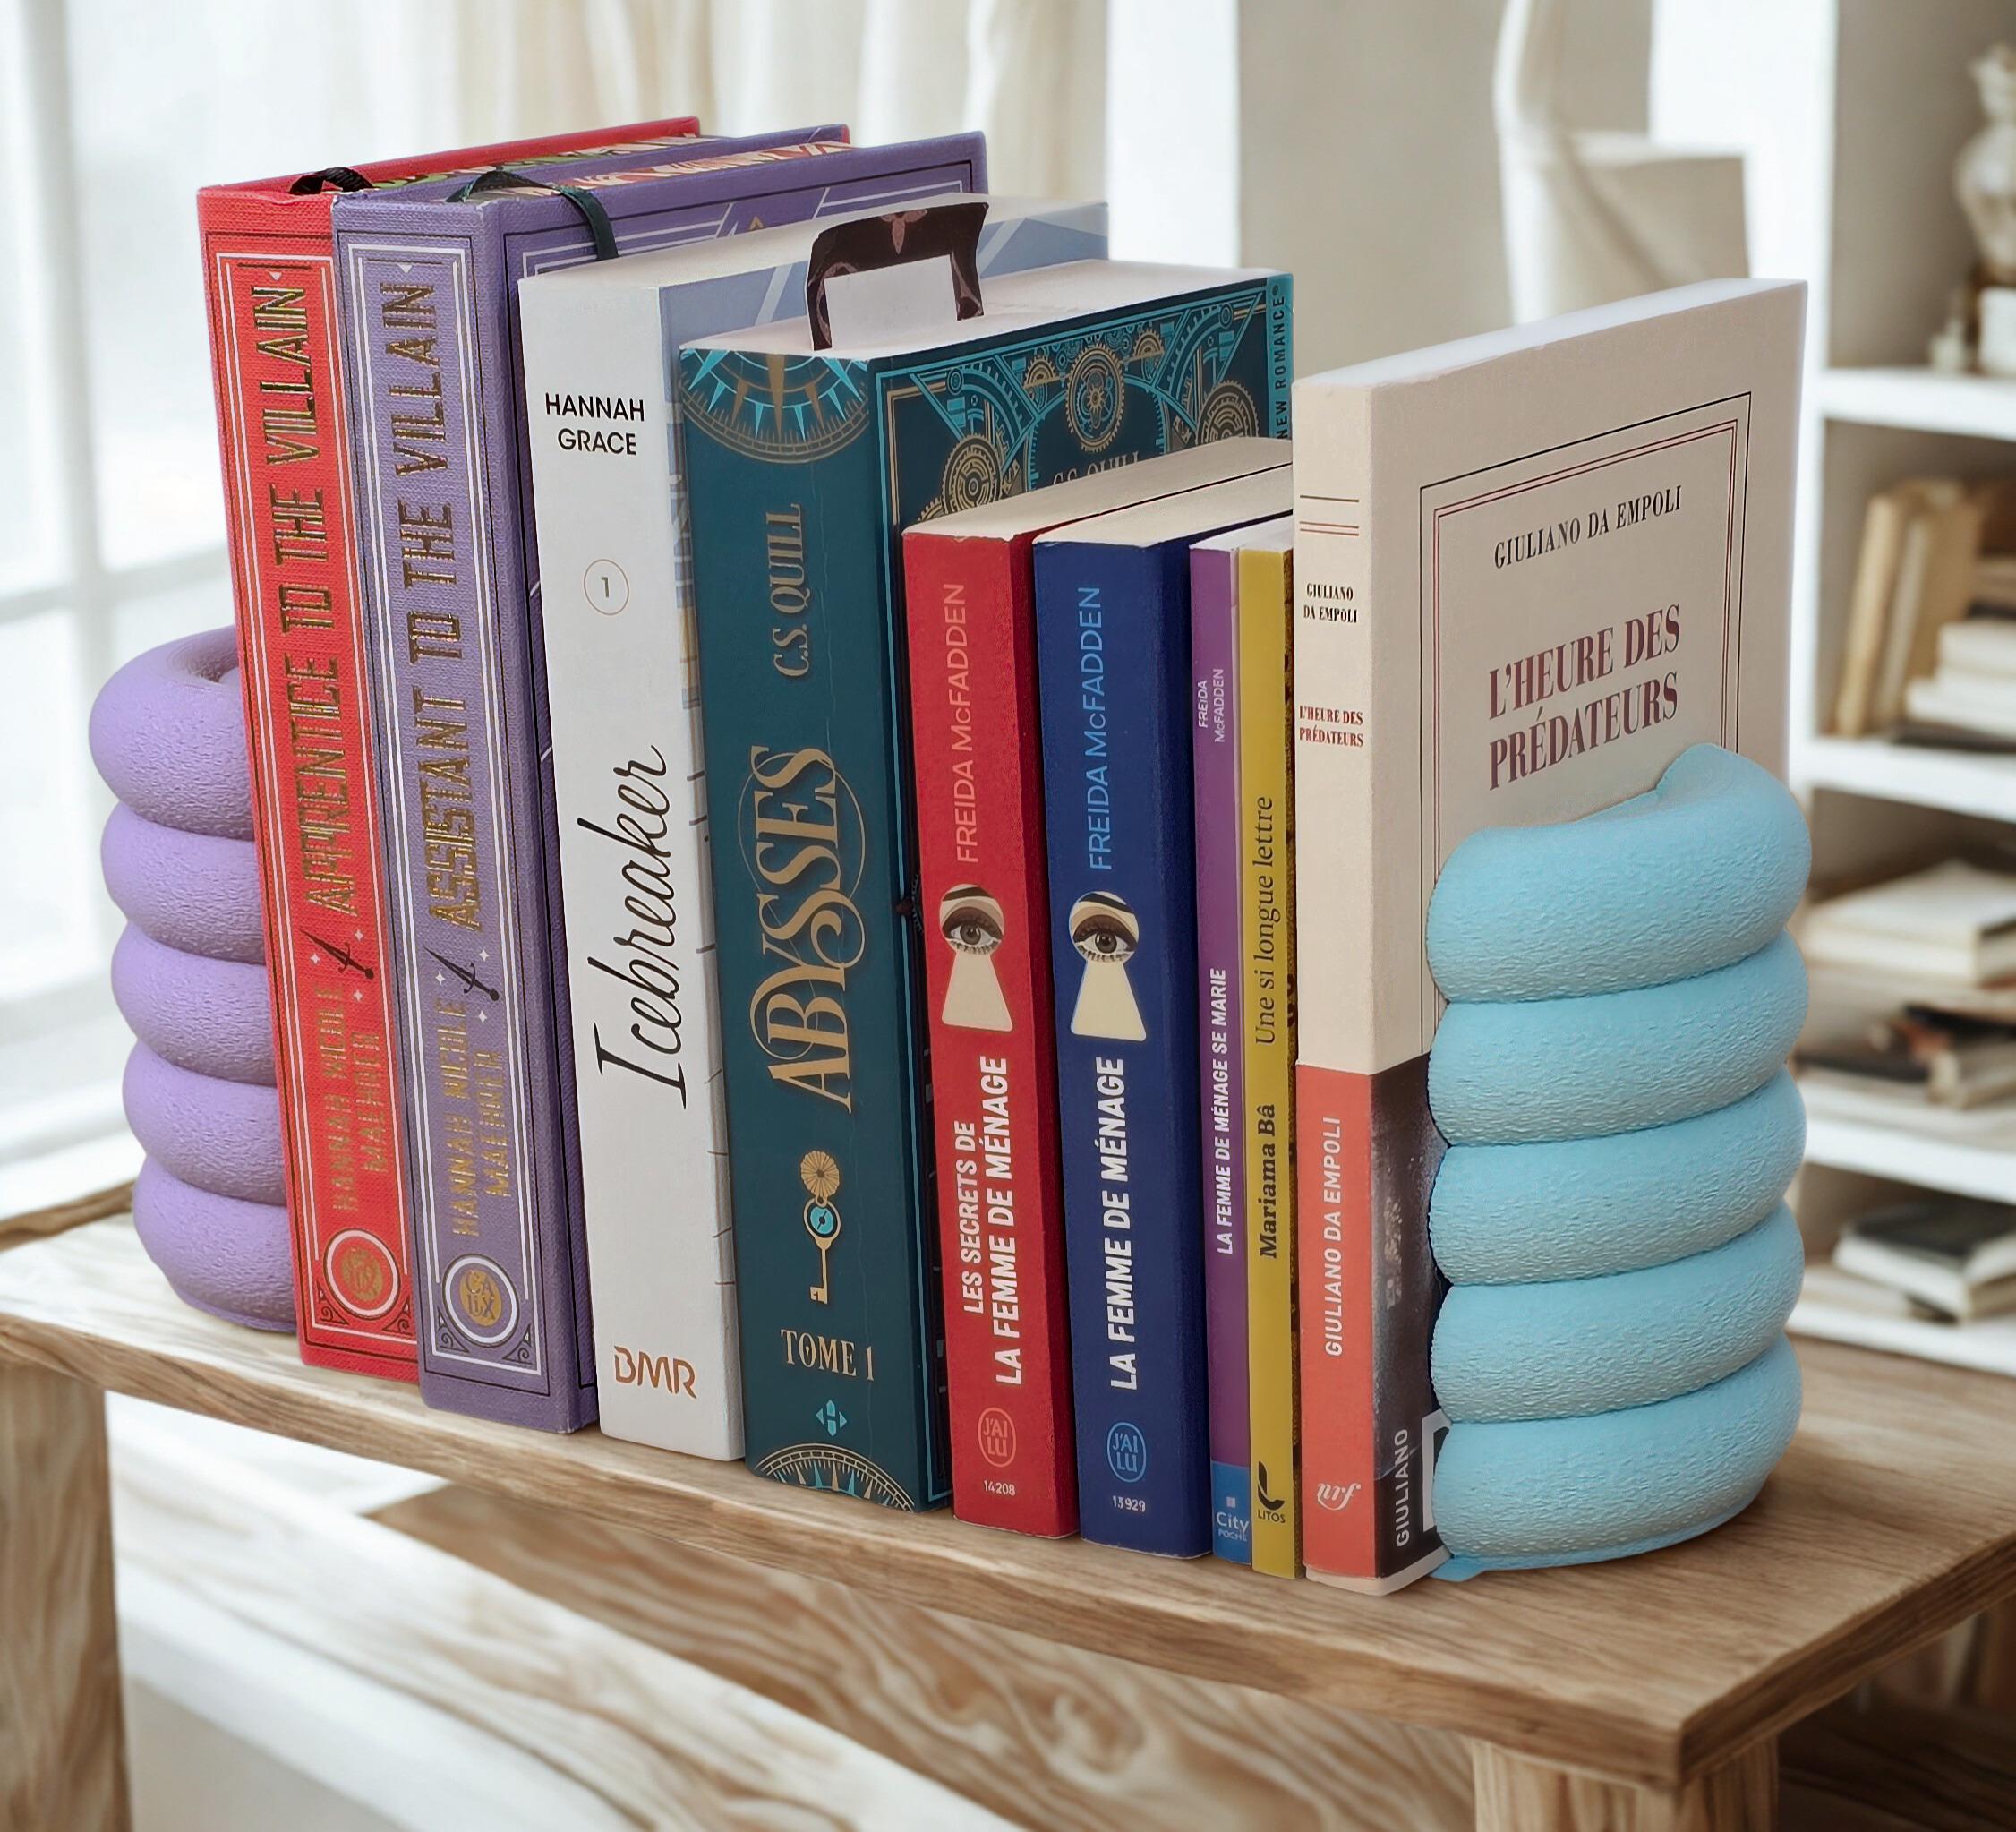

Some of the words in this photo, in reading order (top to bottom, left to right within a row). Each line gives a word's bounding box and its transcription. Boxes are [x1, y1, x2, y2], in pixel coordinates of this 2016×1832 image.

[251, 286, 322, 465] VILLAIN
[380, 282, 448, 475] VILLAIN
[545, 392, 645, 421] HANNAH
[1277, 398, 1287, 439] NEW
[558, 428, 636, 455] GRACE
[269, 484, 329, 565] THE
[397, 498, 457, 588] THE
[1494, 518, 1580, 570] GIULIANO
[1586, 510, 1610, 542] DA
[1616, 484, 1683, 531] EMPOLI
[765, 502, 811, 616] QUILL
[279, 585, 335, 635] TO
[601, 577, 609, 598] 1
[1303, 604, 1316, 620] DA
[1319, 606, 1358, 624] EMPOLI
[1306, 583, 1354, 602] GIULIANO
[407, 609, 463, 663] TO
[773, 624, 809, 678] C.S.
[1489, 626, 1614, 719] L'HEURE
[1624, 604, 1680, 669] DES
[943, 584, 973, 752] McFADDEN
[1077, 587, 1107, 756] McFADDEN
[1198, 680, 1208, 729] FREIDA
[1214, 669, 1226, 742] McFADDEN
[1343, 710, 1363, 726] DES
[1489, 671, 1679, 792] PRÉDATEURS
[1299, 724, 1364, 748] PRÉDATEURS
[285, 654, 358, 917] APPRENTICE
[413, 684, 483, 932] ASSISTANT
[954, 760, 979, 864] FREIDA
[1087, 766, 1113, 869] FREIDA
[1253, 796, 1274, 867] lettre
[577, 745, 686, 1109] Icebreaker
[748, 745, 865, 1114] ABYSSES
[1254, 872, 1280, 963] longue
[1209, 967, 1227, 1028] MARIE
[1255, 968, 1275, 990] si
[1211, 1031, 1228, 1054] SE
[1256, 997, 1276, 1046] Une
[978, 1055, 1011, 1180] MÉNAGE
[1093, 1057, 1127, 1183] MÉNAGE
[1210, 1059, 1229, 1131] MÉNAGE
[1257, 1103, 1276, 1137] Bâ
[953, 1120, 976, 1152] DE
[1215, 1137, 1230, 1160] DE
[1322, 1116, 1342, 1205] EMPOLI
[957, 1160, 980, 1264] SECRETS
[986, 1186, 1013, 1230] DE
[1102, 1190, 1130, 1231] DE
[1215, 1165, 1233, 1228] FEMME
[1258, 1143, 1277, 1260] Mariama
[1217, 1232, 1234, 1255] LA
[1323, 1213, 1342, 1243] DA
[963, 1271, 985, 1314] LES
[988, 1235, 1021, 1340] FEMME
[1104, 1237, 1137, 1343] FEMME
[1324, 1250, 1343, 1357] GIULIANO
[614, 1345, 697, 1400] BMR
[781, 1329, 856, 1376] TOME
[867, 1347, 874, 1381] 1
[995, 1348, 1022, 1386] LA
[1111, 1353, 1138, 1391] LA
[982, 1417, 1008, 1437] J'AI
[987, 1436, 1008, 1457] LU
[1112, 1433, 1138, 1452] J'AI
[1116, 1452, 1137, 1473] LU
[1395, 1428, 1410, 1546] GIULIANO
[1217, 1511, 1249, 1534] City
[1258, 1510, 1286, 1523] LITOS
